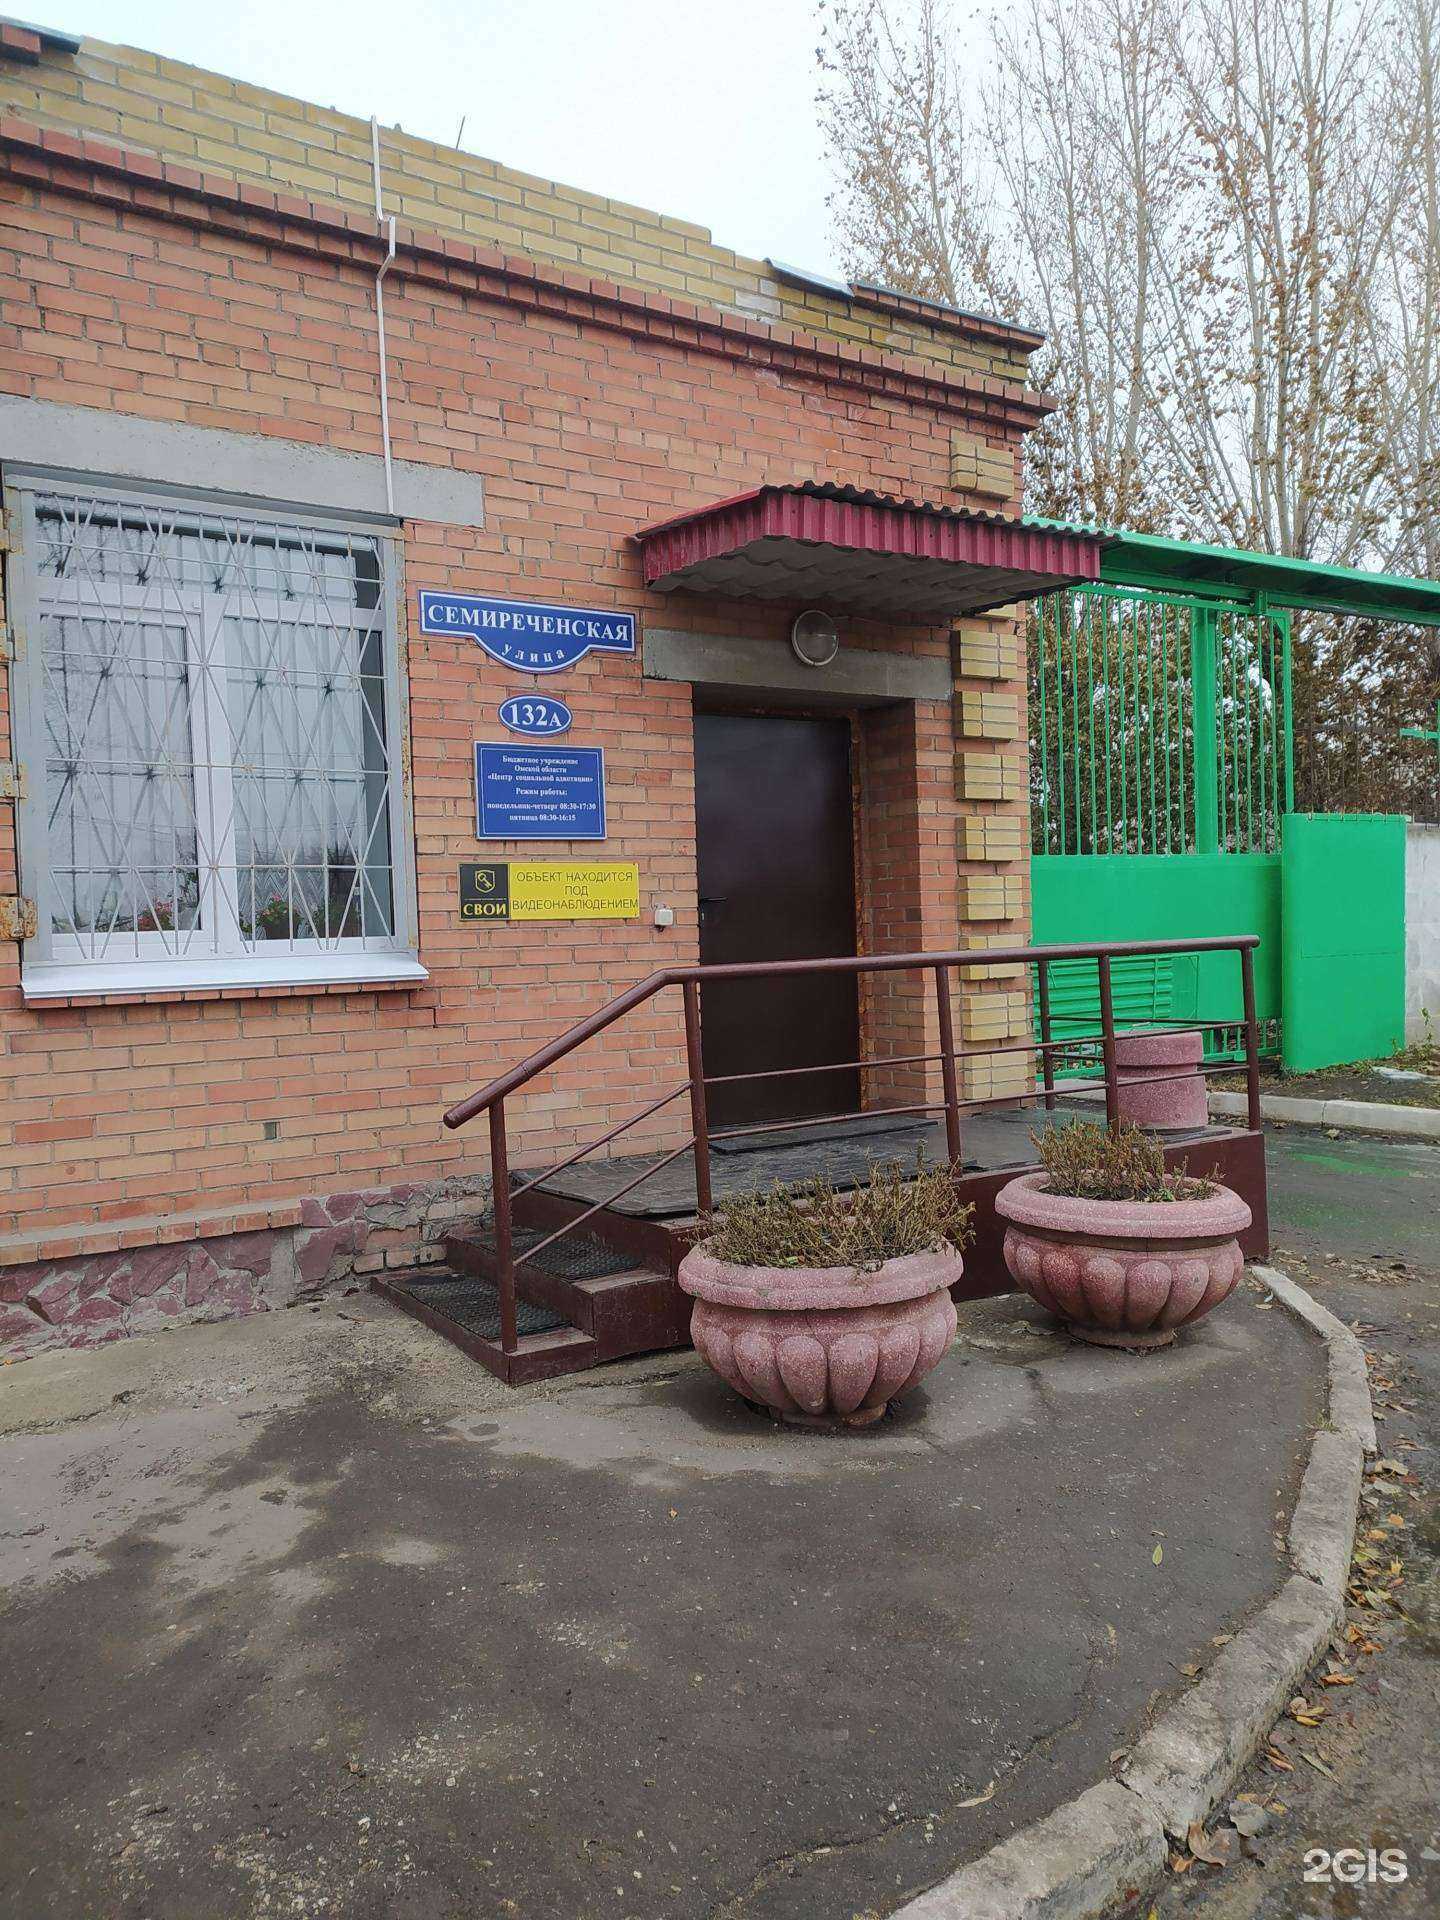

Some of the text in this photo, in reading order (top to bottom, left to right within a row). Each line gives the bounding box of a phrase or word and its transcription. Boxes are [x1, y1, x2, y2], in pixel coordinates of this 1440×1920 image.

[428, 604, 628, 641] СЕМИРЕЧЕНСКАЯ
[501, 644, 565, 664] улица
[502, 755, 538, 764] Бюджетное
[514, 765, 540, 773] Омской
[487, 774, 512, 782] «Центр
[516, 787, 568, 796] Режим работы:
[517, 872, 633, 883] ОБЪЕКТ НАХОДИТСЯ
[564, 886, 589, 897] ПОД
[463, 903, 507, 916] СВОИ
[512, 899, 638, 911] ВИДЕОНАБЛЮДЕНИЕМ
